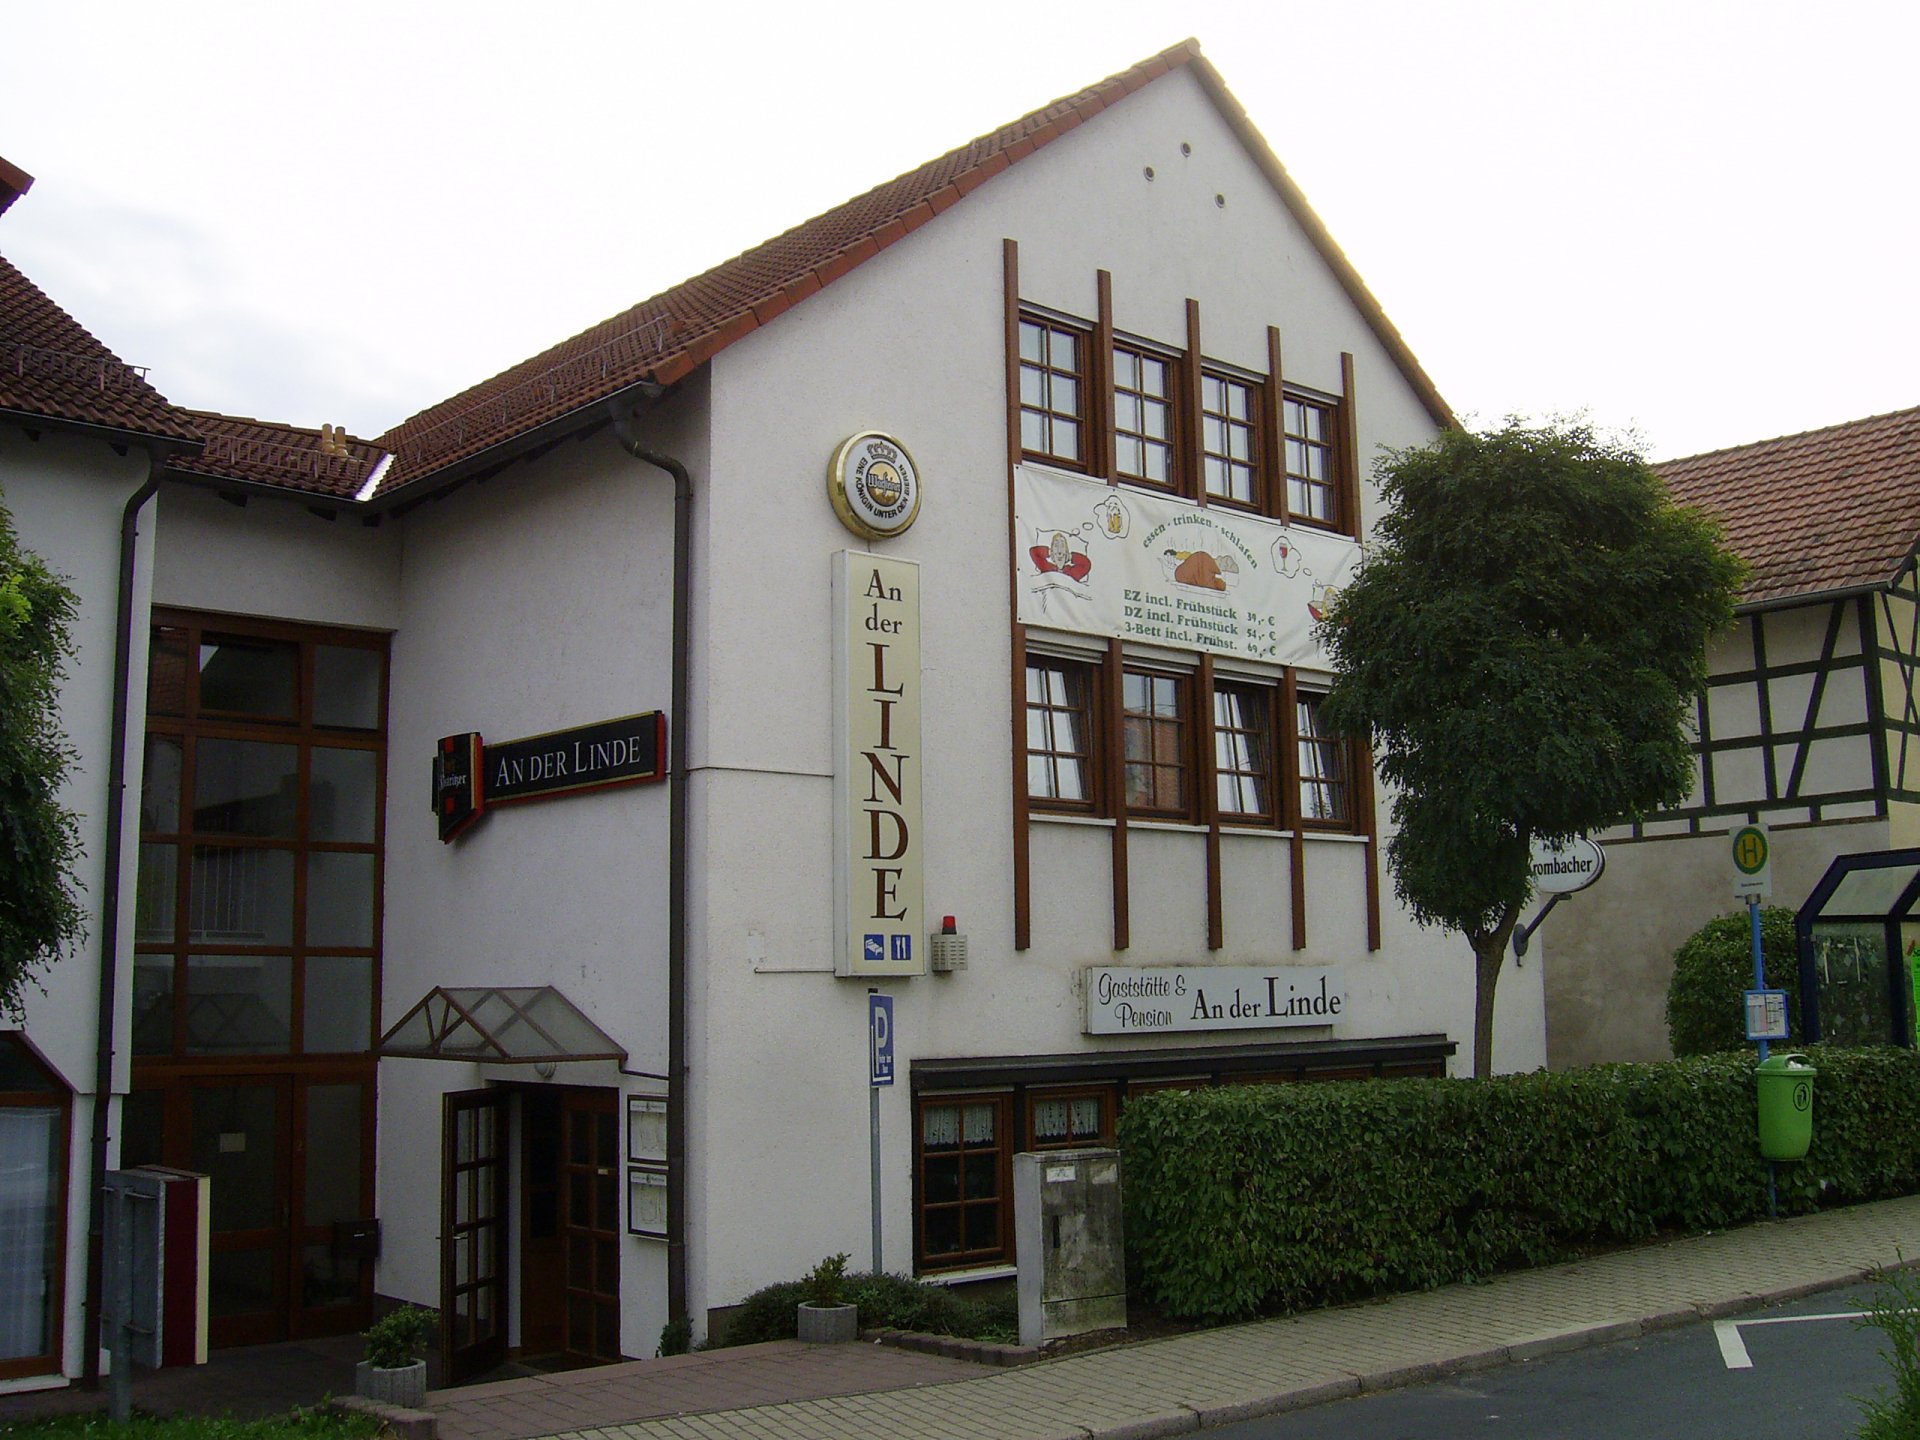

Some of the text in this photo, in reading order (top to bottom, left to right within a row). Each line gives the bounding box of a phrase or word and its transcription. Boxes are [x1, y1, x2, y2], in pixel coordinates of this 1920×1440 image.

[874, 508, 898, 519] UNTER
[898, 497, 909, 514] DEN
[1142, 513, 1258, 569] essen trinken schlafen
[864, 569, 902, 601] An
[865, 602, 902, 634] der
[1124, 589, 1141, 602] EZ
[1145, 592, 1172, 607] incl.
[1176, 598, 1237, 620] Frühstück
[1124, 606, 1143, 619] DZ
[1147, 609, 1174, 624] incl.
[1177, 615, 1238, 635] Frühstück
[1125, 622, 1161, 637] 3-Bett
[1165, 627, 1192, 642] incl.
[1196, 633, 1237, 650] Frühst.
[496, 735, 641, 787] AN DER LINDE
[860, 642, 910, 922] LINDE
[1532, 856, 1593, 876] rombacher
[1742, 837, 1758, 865] H
[1098, 973, 1187, 1005] Gaststätte &
[1190, 975, 1342, 1020] An der Linde
[1114, 1002, 1173, 1028] Pension
[874, 1006, 889, 1075] P
